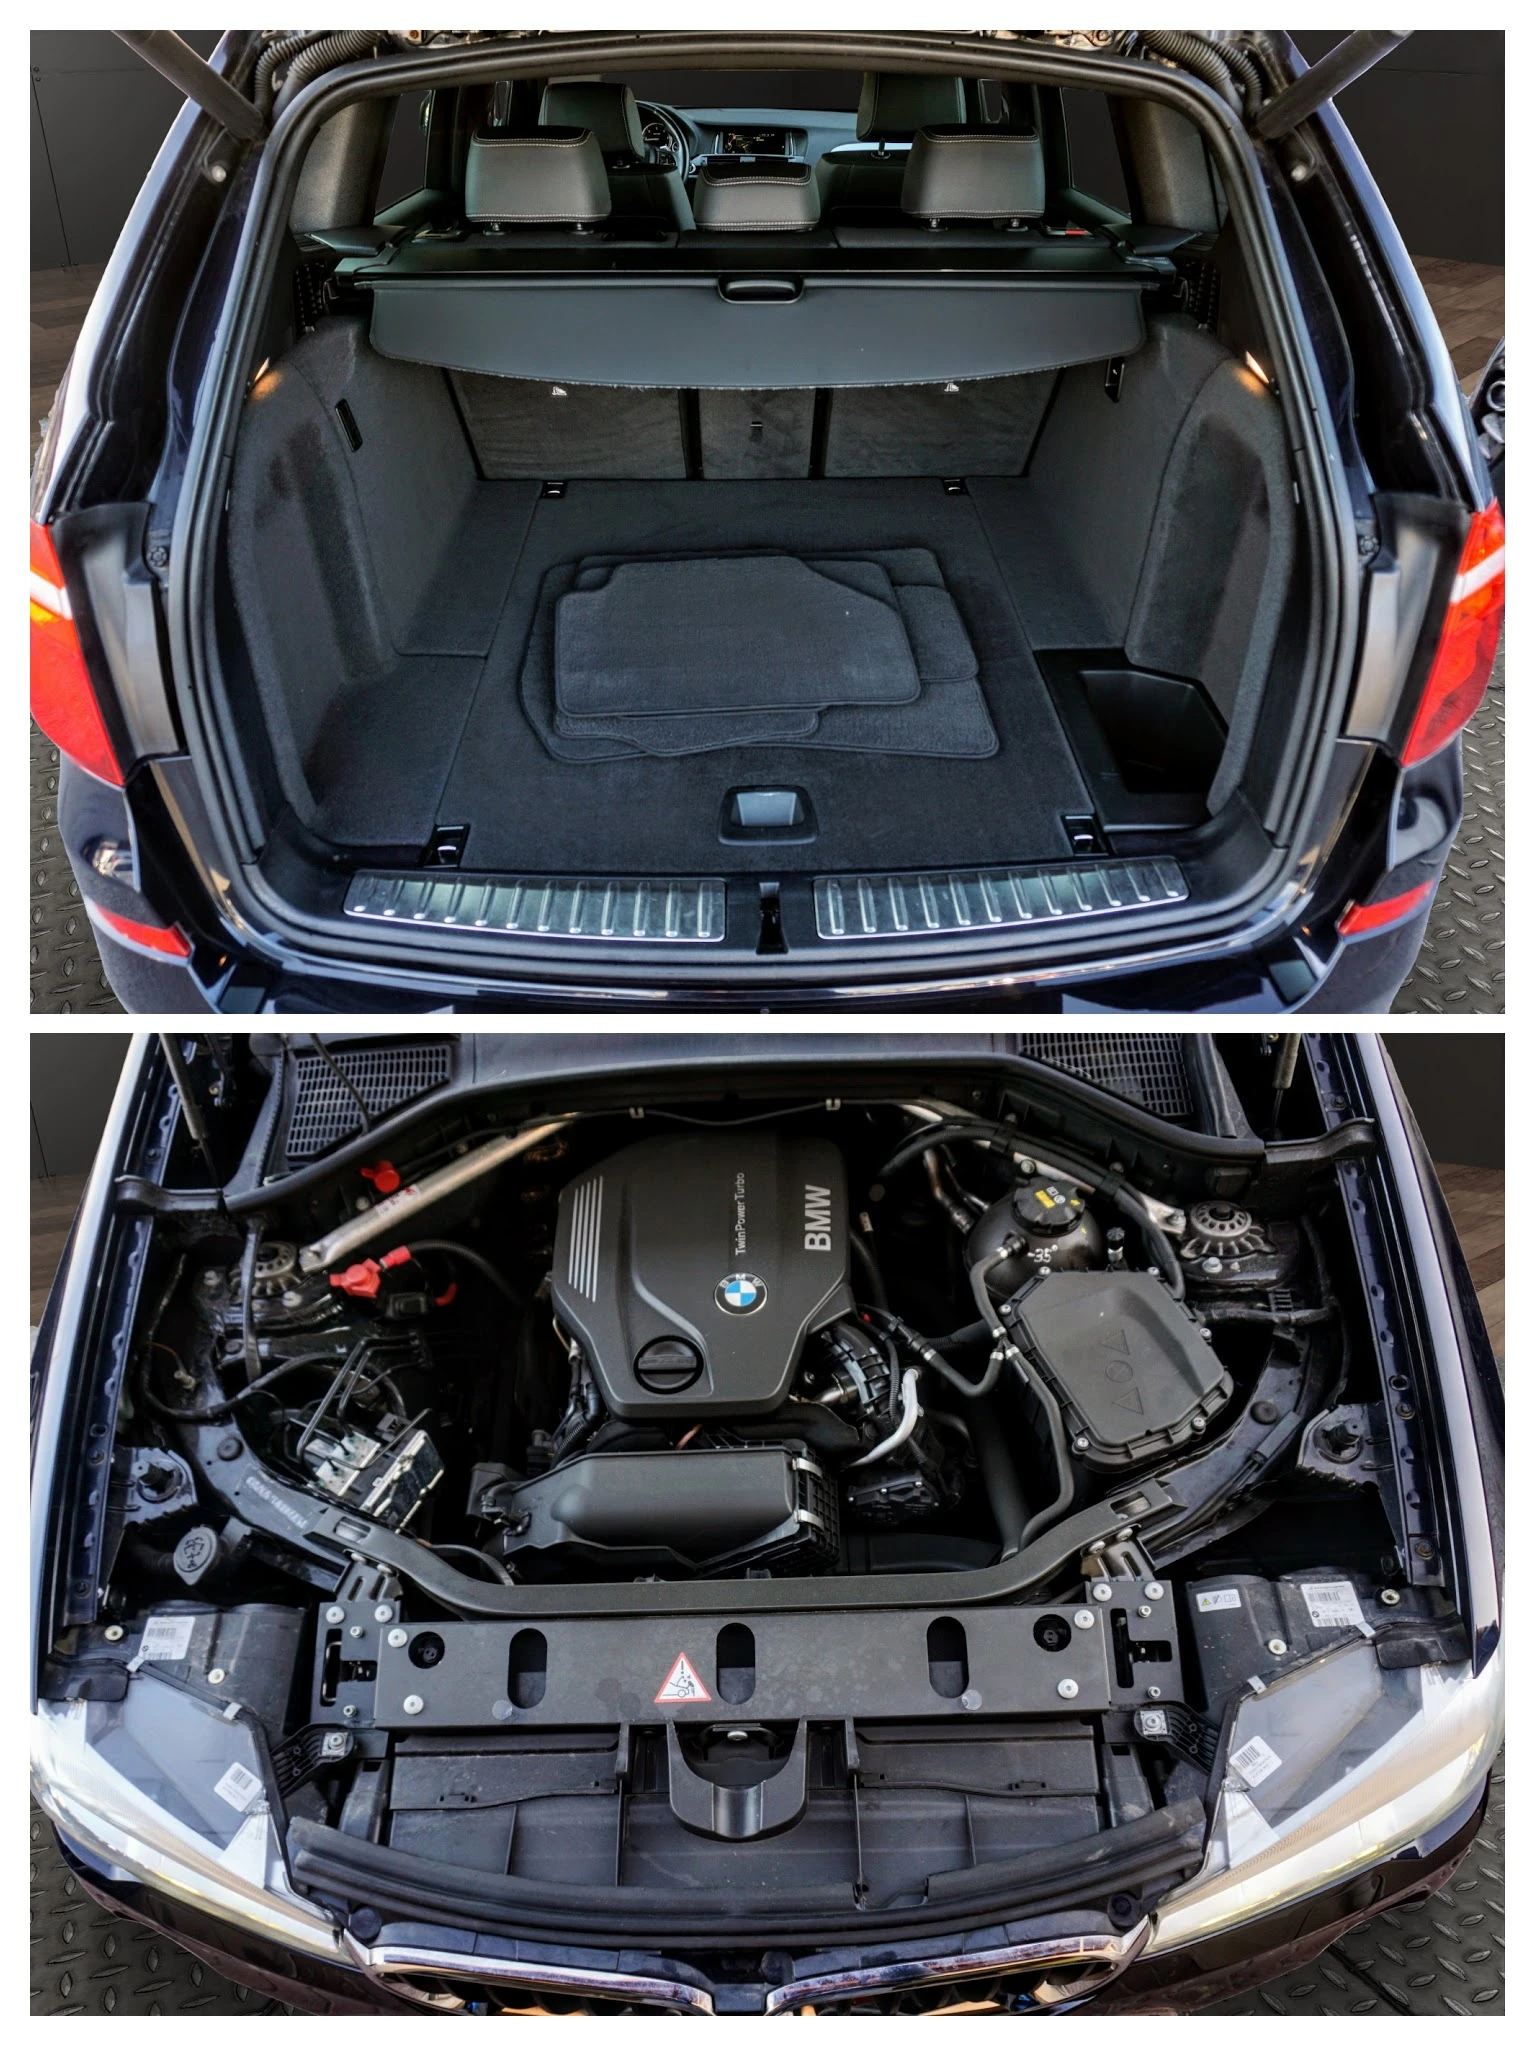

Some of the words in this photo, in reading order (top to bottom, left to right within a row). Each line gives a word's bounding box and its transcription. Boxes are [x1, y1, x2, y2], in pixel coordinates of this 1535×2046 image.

[734, 1172, 745, 1201] Turbo
[735, 1201, 746, 1256] TwinPower
[804, 1184, 832, 1251] BMW
[719, 1273, 764, 1289] BMW
